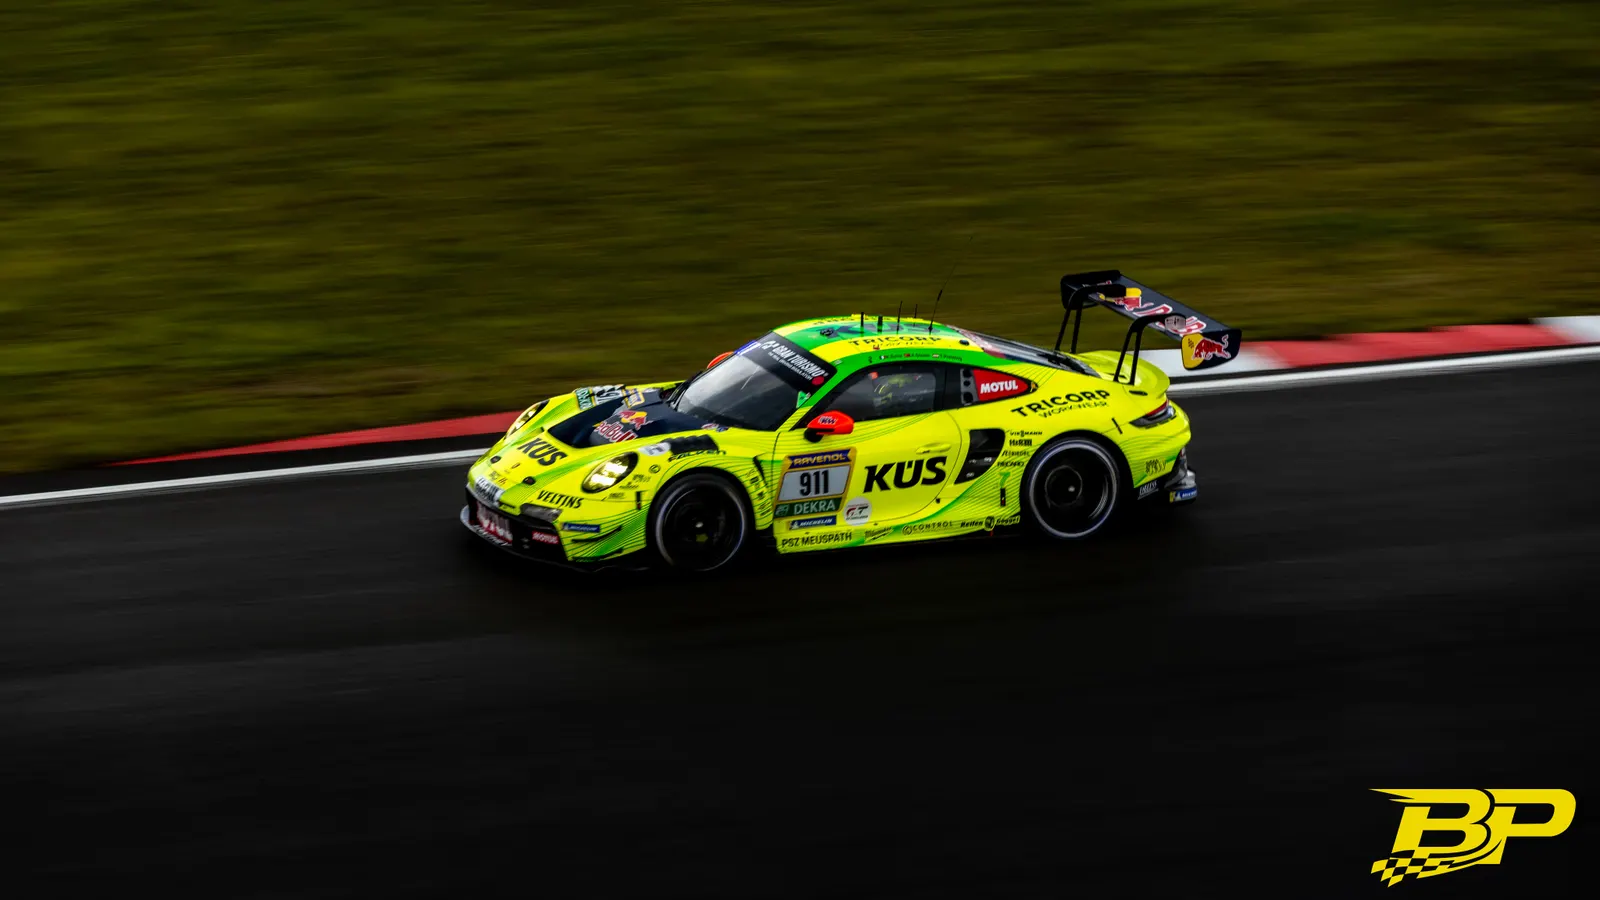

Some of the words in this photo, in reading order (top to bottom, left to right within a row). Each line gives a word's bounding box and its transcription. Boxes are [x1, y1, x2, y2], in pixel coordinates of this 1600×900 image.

[787, 354, 826, 377] TURISMO
[980, 379, 1019, 394] MOTUL
[1010, 389, 1110, 417] TRICORP
[517, 437, 568, 466] KÜS
[793, 453, 847, 466] RAVENOL
[799, 469, 830, 497] 911
[863, 456, 947, 493] KÜS
[537, 490, 584, 509] VELTINS
[794, 500, 836, 515] DEKRA
[800, 518, 833, 527] MICHELIN
[912, 521, 953, 531] CONTROL
[781, 537, 800, 548] PSZ
[801, 531, 852, 546] MEUSPATH
